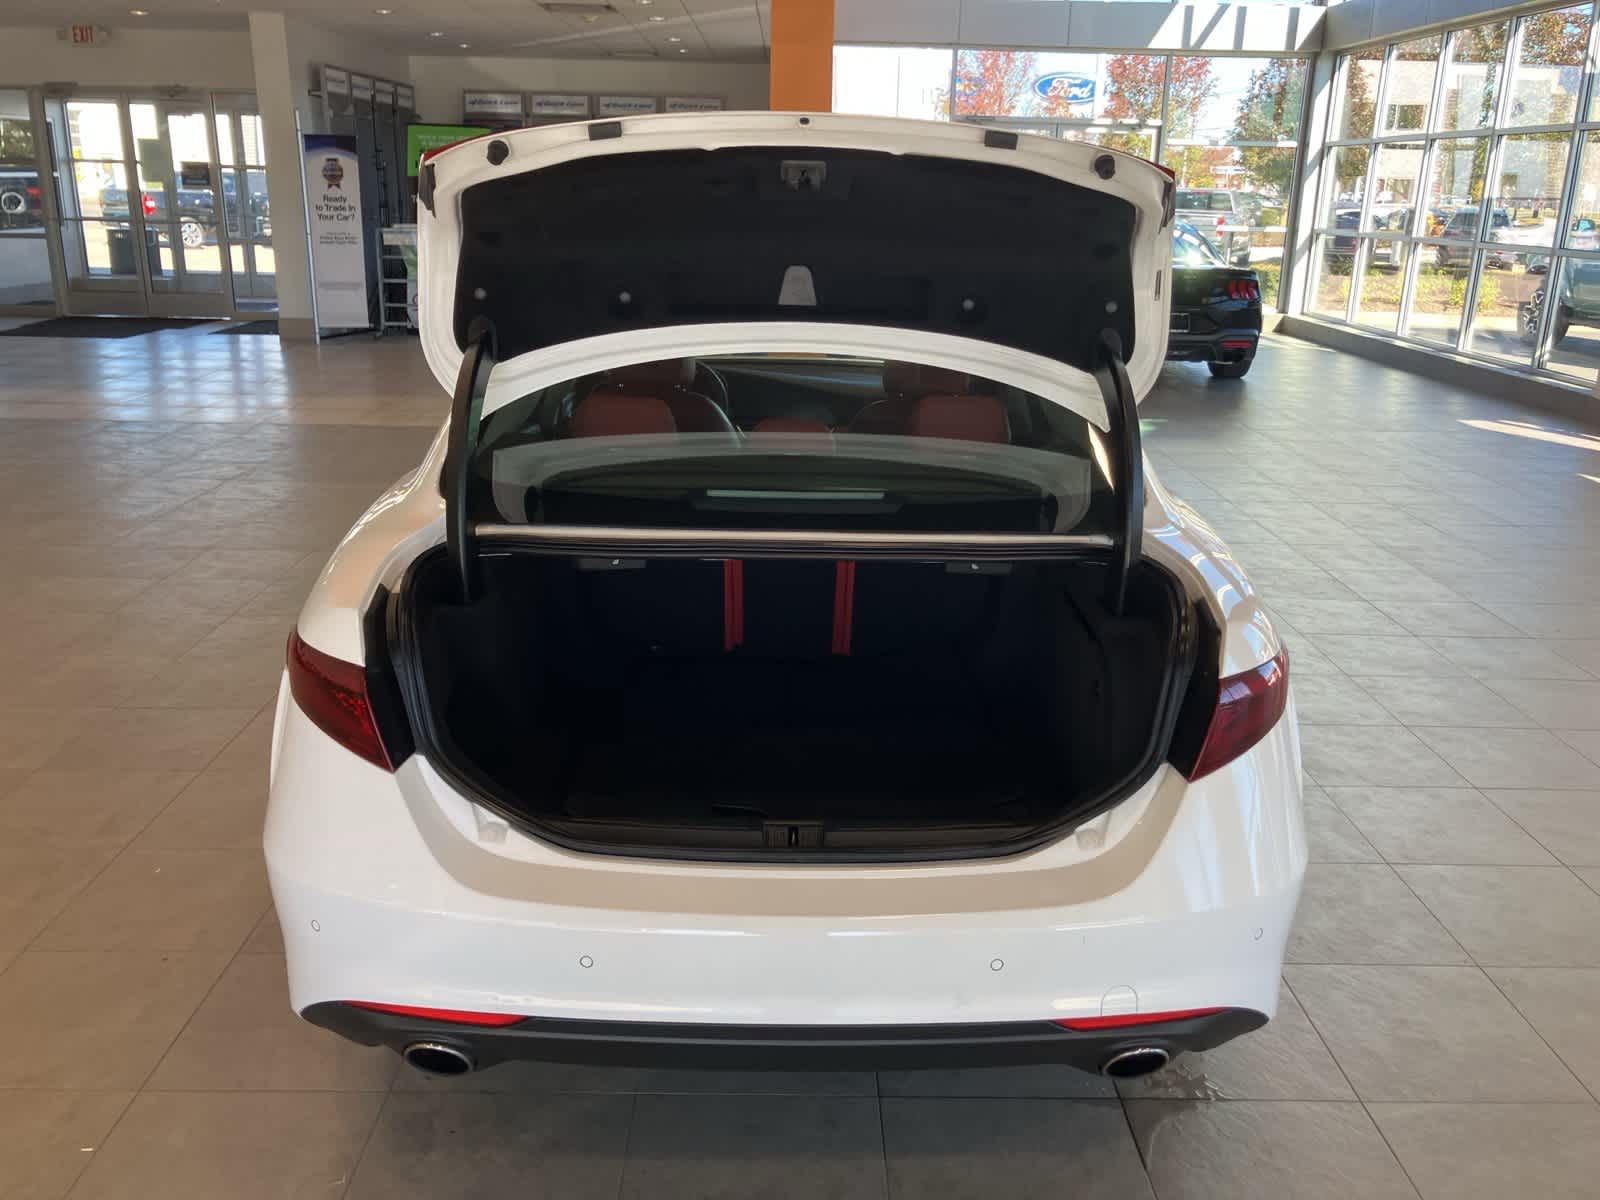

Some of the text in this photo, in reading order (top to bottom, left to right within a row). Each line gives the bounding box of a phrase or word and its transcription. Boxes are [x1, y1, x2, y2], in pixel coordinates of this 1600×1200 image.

[72, 25, 96, 44] EXIT
[1047, 77, 1092, 99] Ford
[323, 194, 347, 204] Ready
[316, 203, 323, 212] to
[324, 203, 347, 212] Trade
[317, 213, 355, 222] Your Car?
